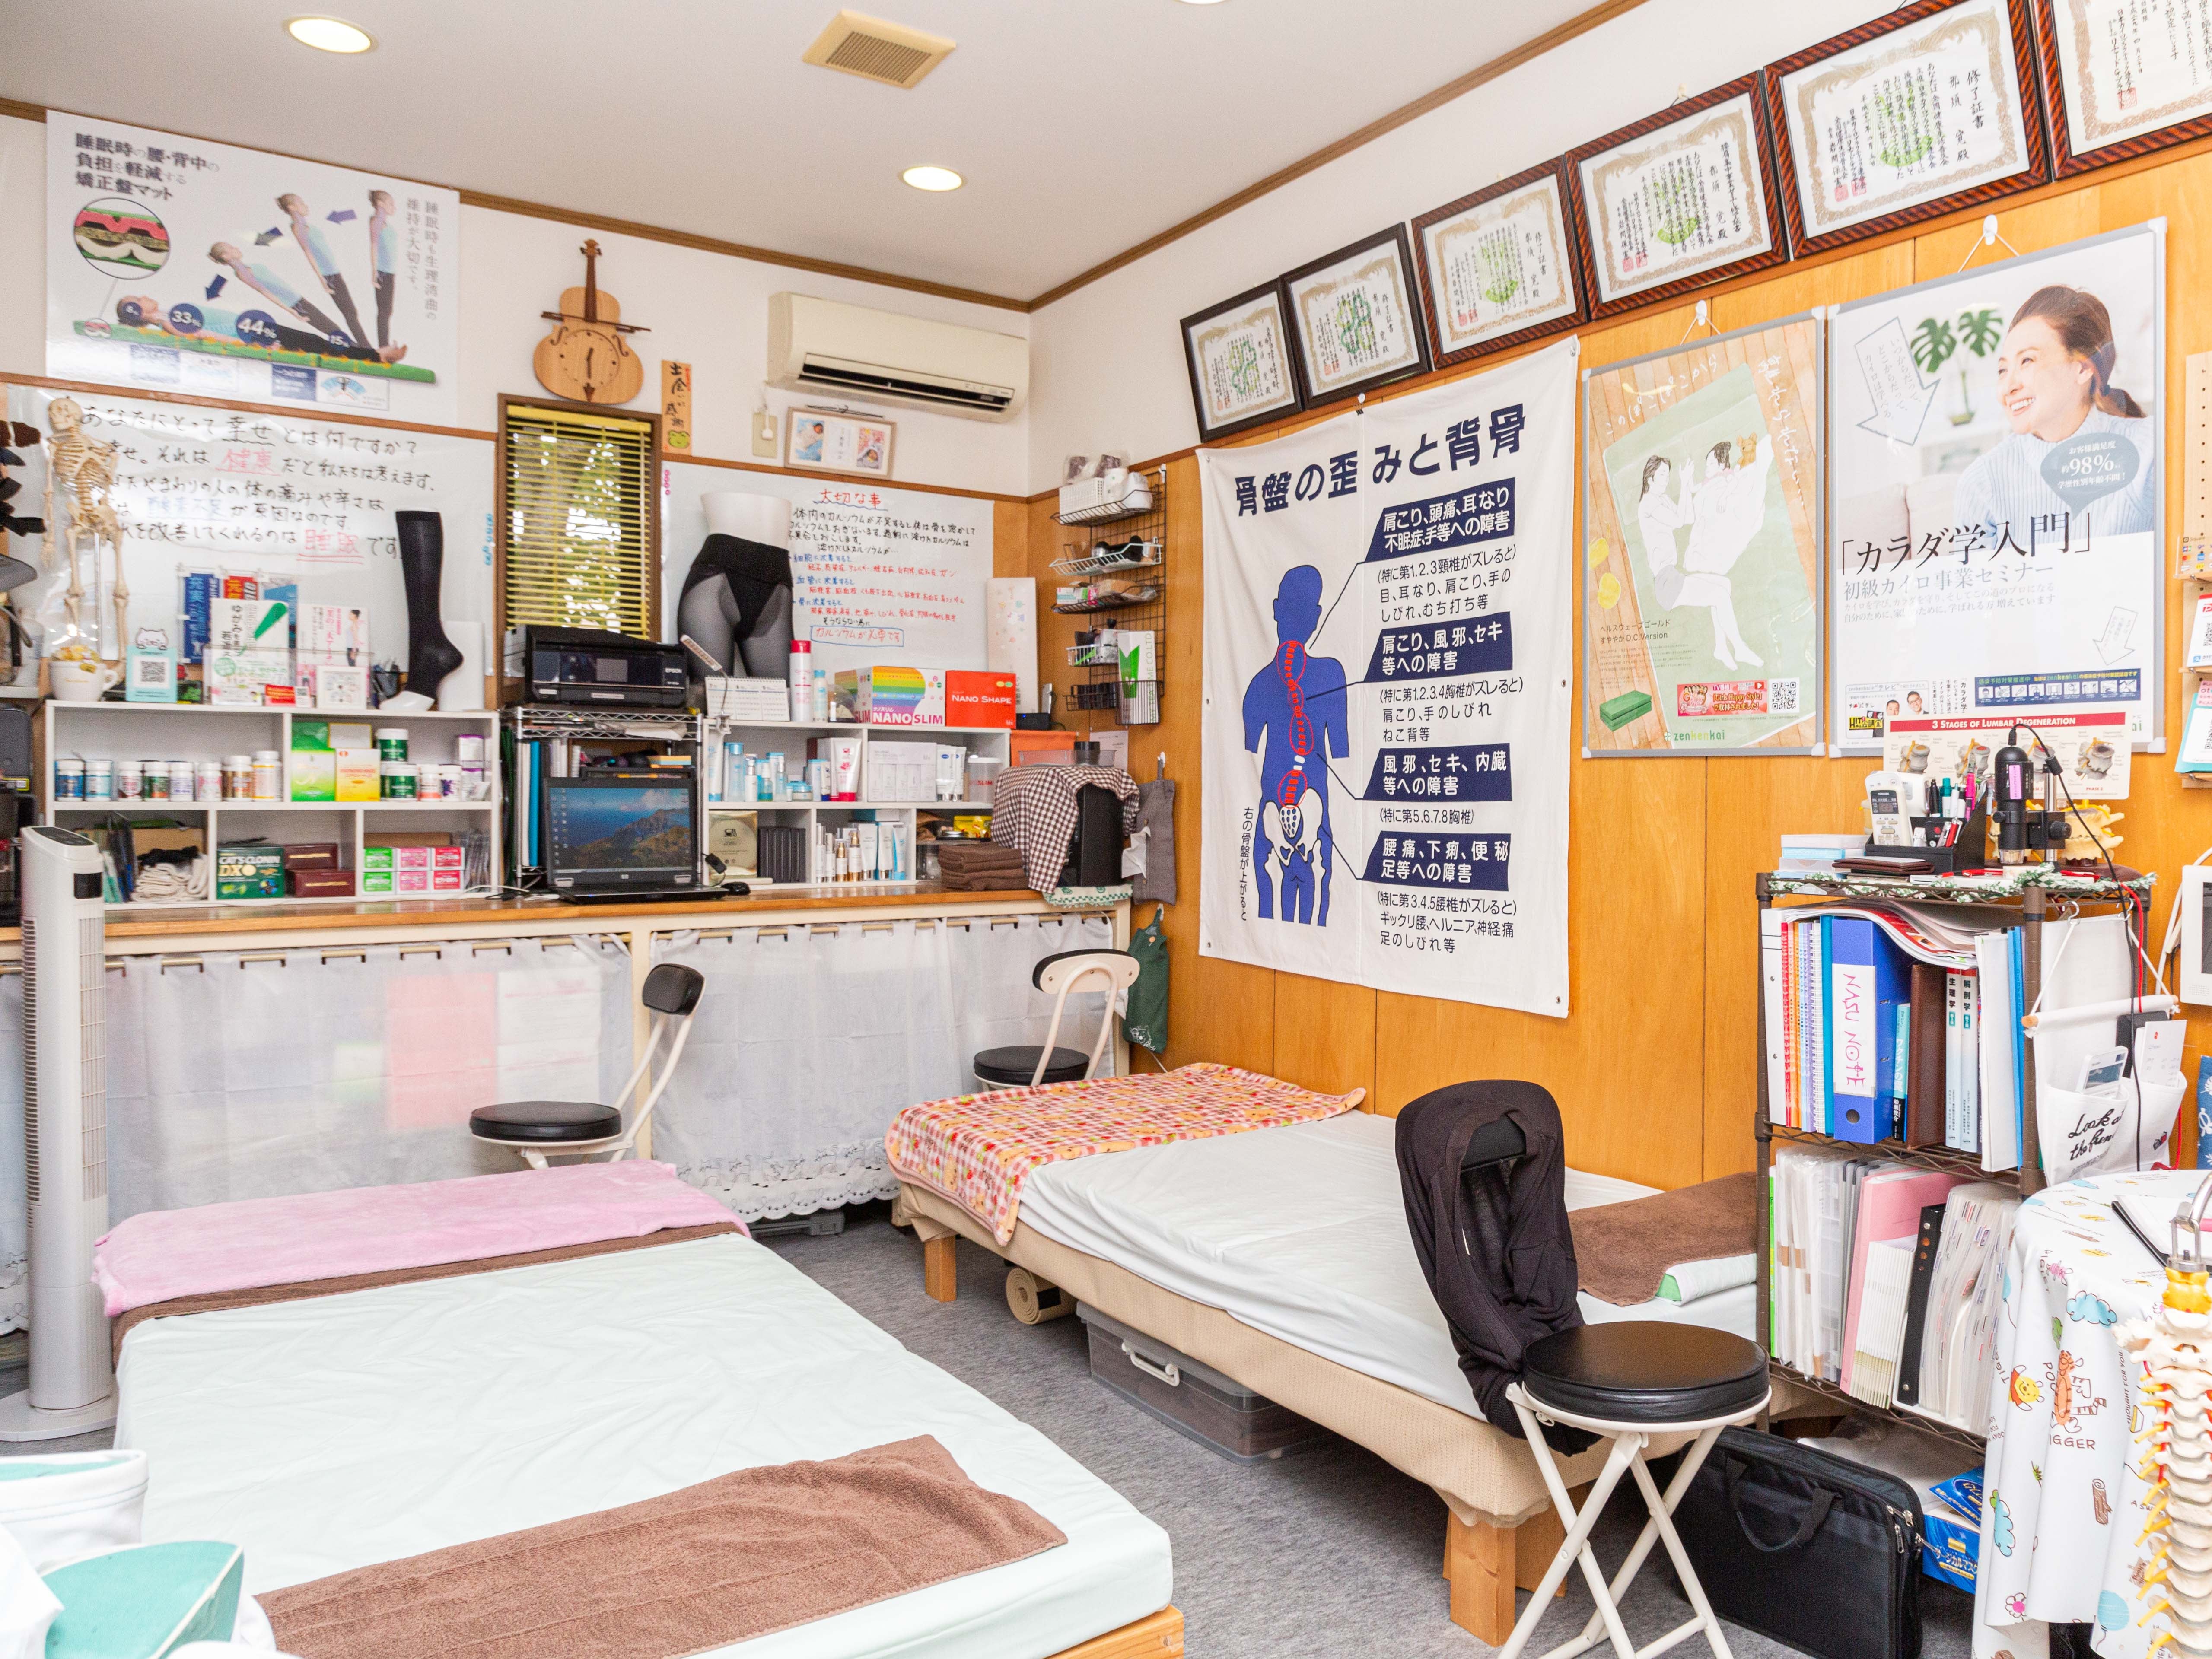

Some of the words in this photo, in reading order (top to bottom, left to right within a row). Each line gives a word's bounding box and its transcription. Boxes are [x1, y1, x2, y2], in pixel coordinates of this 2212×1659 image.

[1967, 69, 1984, 129] 修了証書
[75, 132, 220, 172] 睡眠時の腰・背中の
[75, 151, 187, 186] 負担を軽減する
[75, 170, 173, 201] 矯正盤マット
[1535, 232, 1547, 276] 修了証書
[172, 309, 201, 327] 33%
[237, 318, 277, 340] 44%
[1234, 402, 1527, 518] 骨盤の歪みと背骨
[820, 489, 882, 509] 大切な事
[1383, 486, 1509, 532] 肩こり、頭痛、耳なり
[1384, 510, 1510, 553] 不眠症、手等への障害
[1842, 511, 2091, 575] 「カラダ学入門」
[1381, 568, 1511, 603] 目、耳なり、肩こり、手の
[1843, 562, 2053, 601] 初級カイロ事業セミナー
[1381, 594, 1489, 623] しびれ、むち打ち等
[815, 627, 900, 642] カルシウムが必要です
[1383, 621, 1503, 655] 肩こり、風邪、セキ
[1600, 619, 1671, 632] ヘルスウェーブゴールド
[1382, 651, 1458, 676] 等への障害
[952, 694, 980, 703] NANO
[1728, 692, 1746, 702] Happy
[873, 713, 913, 724] NANO
[914, 714, 943, 725] SLIM
[1383, 702, 1492, 723] 肩こり、手のしびれ
[1940, 720, 1967, 728] STAGES
[1982, 718, 2014, 727] LUMBAR
[2016, 717, 2076, 726] DEGENERATION
[1383, 727, 1430, 742] ねこ背等
[1674, 730, 1725, 741] zenkenkai
[1383, 750, 1507, 774] 風邪、セキ、内臓
[1383, 776, 1459, 796] 等への障害
[1383, 838, 1509, 861] 腰痛、下痢、便秘
[1239, 806, 1254, 921] 右の骨盤が上がると
[1381, 859, 1472, 884] 足等への障害
[1380, 911, 1514, 938] ギックリ腰、ヘルニア、神経痛
[1381, 931, 1456, 953] 足のしびれ等
[2068, 1108, 2115, 1139] Look
[2070, 1139, 2088, 1161] the
[2123, 1389, 2132, 1424] THOUGHT
[2049, 1434, 2096, 1450] IGGER
